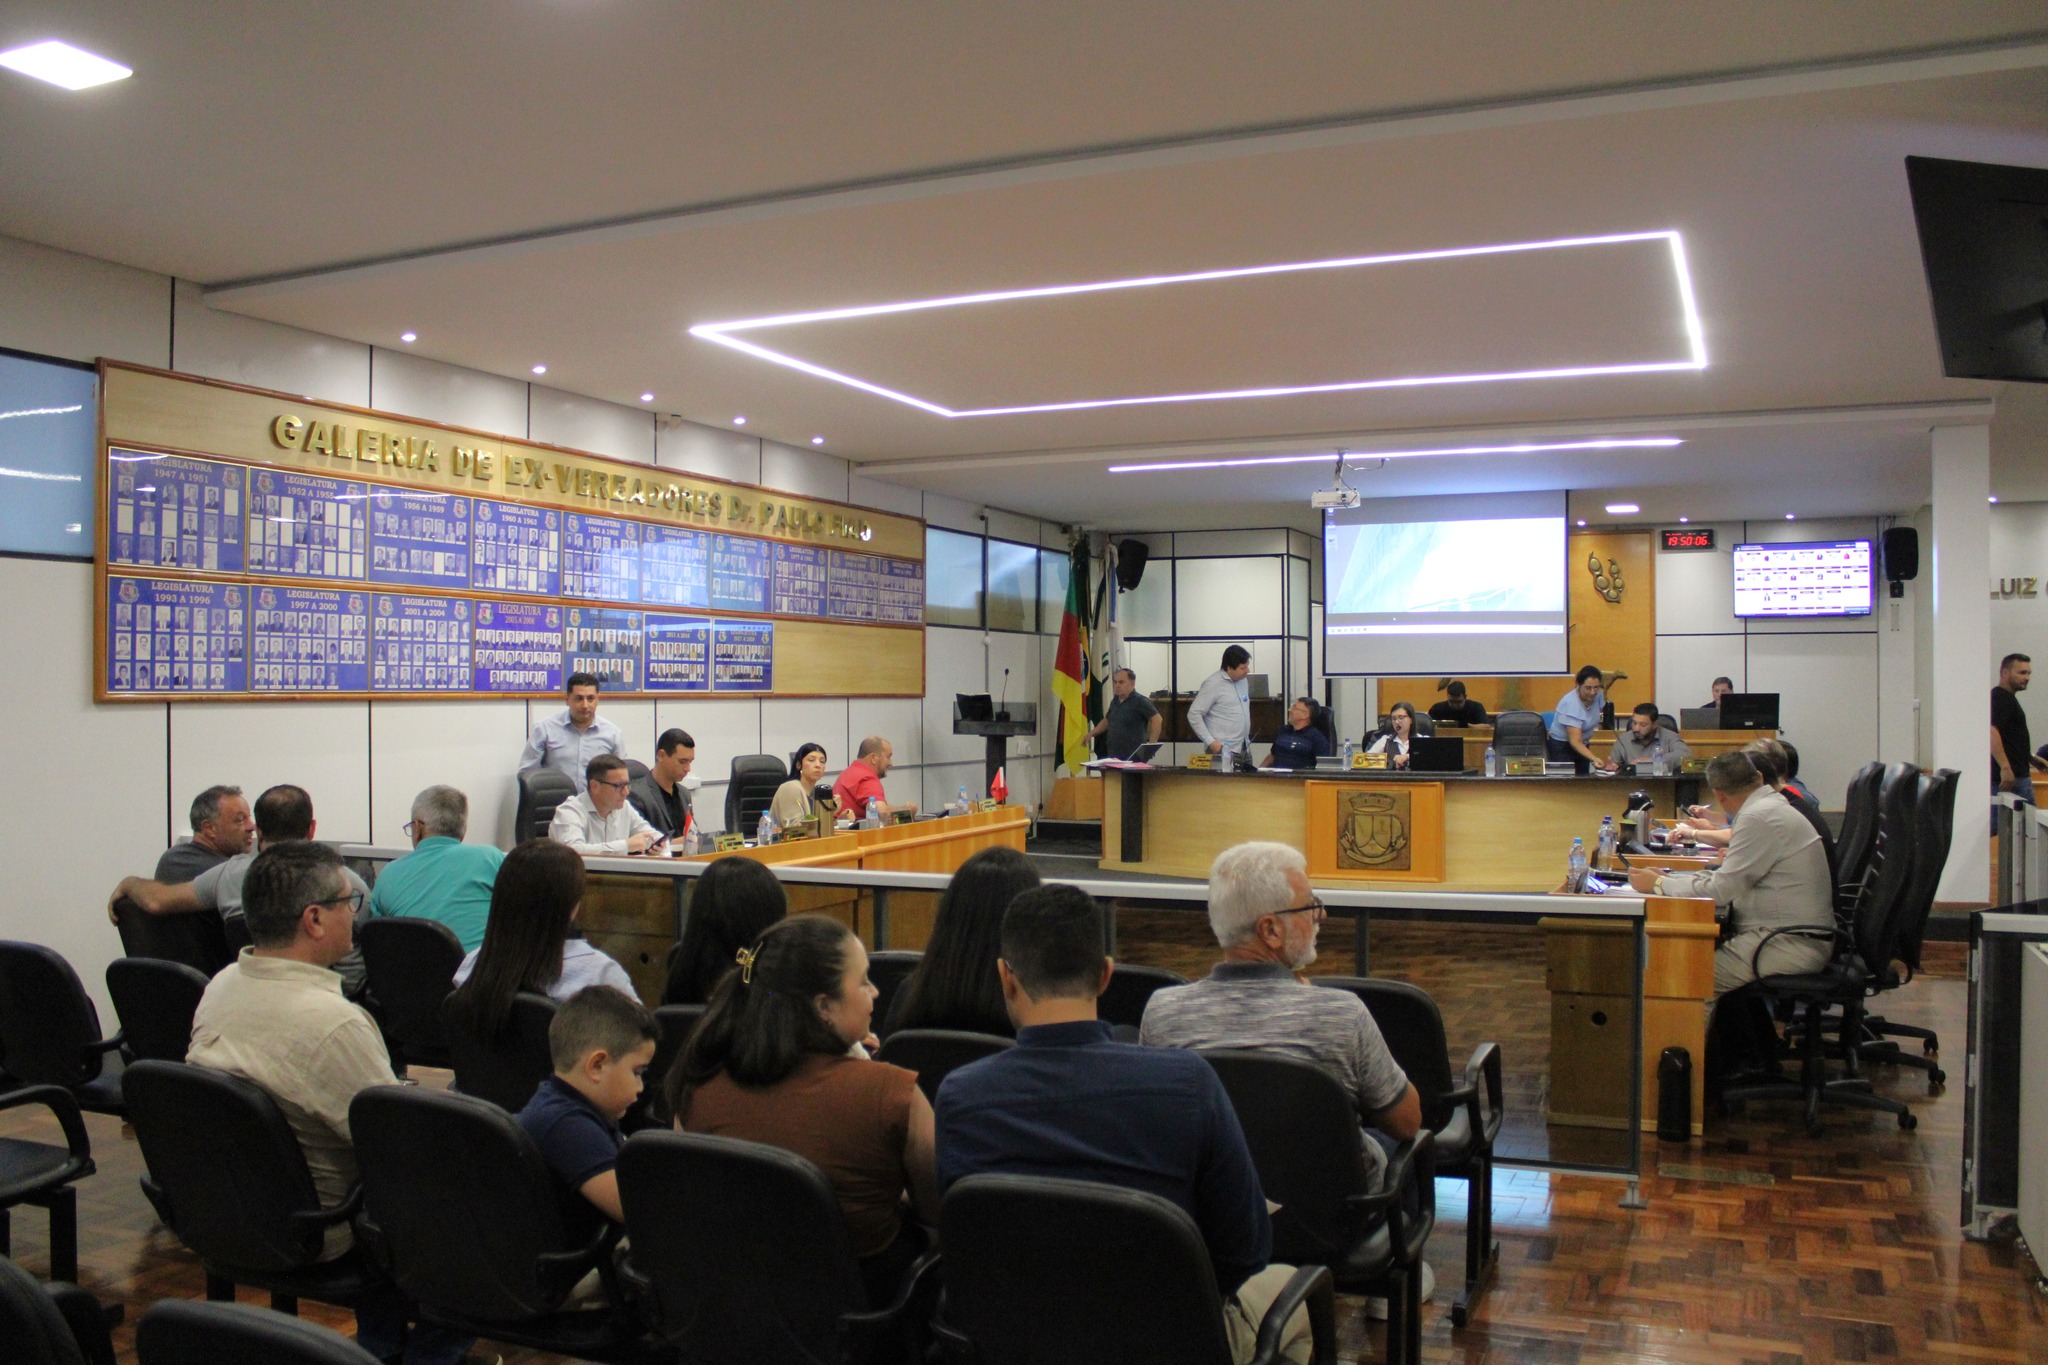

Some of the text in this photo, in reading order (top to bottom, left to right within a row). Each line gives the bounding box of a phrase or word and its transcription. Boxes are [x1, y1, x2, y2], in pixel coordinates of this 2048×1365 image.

[149, 458, 213, 473] LEGISLATURA
[154, 468, 209, 484] 1947 A 1951
[271, 413, 441, 473] GALERIA
[453, 444, 494, 481] DE
[505, 454, 722, 518] EX-VEREADORES
[726, 494, 755, 523] Dr.
[759, 501, 824, 534] PAULO
[284, 475, 338, 490] LEGISLATURA
[307, 489, 314, 497] A
[498, 504, 539, 517] LEGISLATURA
[585, 517, 621, 529] LEGISLATURA
[151, 581, 214, 594] LEGISLATURA
[155, 593, 211, 605] 1993 A 1996
[286, 589, 340, 601] LEGISLATURA
[290, 600, 338, 611] 1997 A 2000
[401, 597, 448, 608] LEGISLATURA
[404, 607, 446, 617] 2001 A 2004
[498, 603, 542, 616] LEGISLATURA
